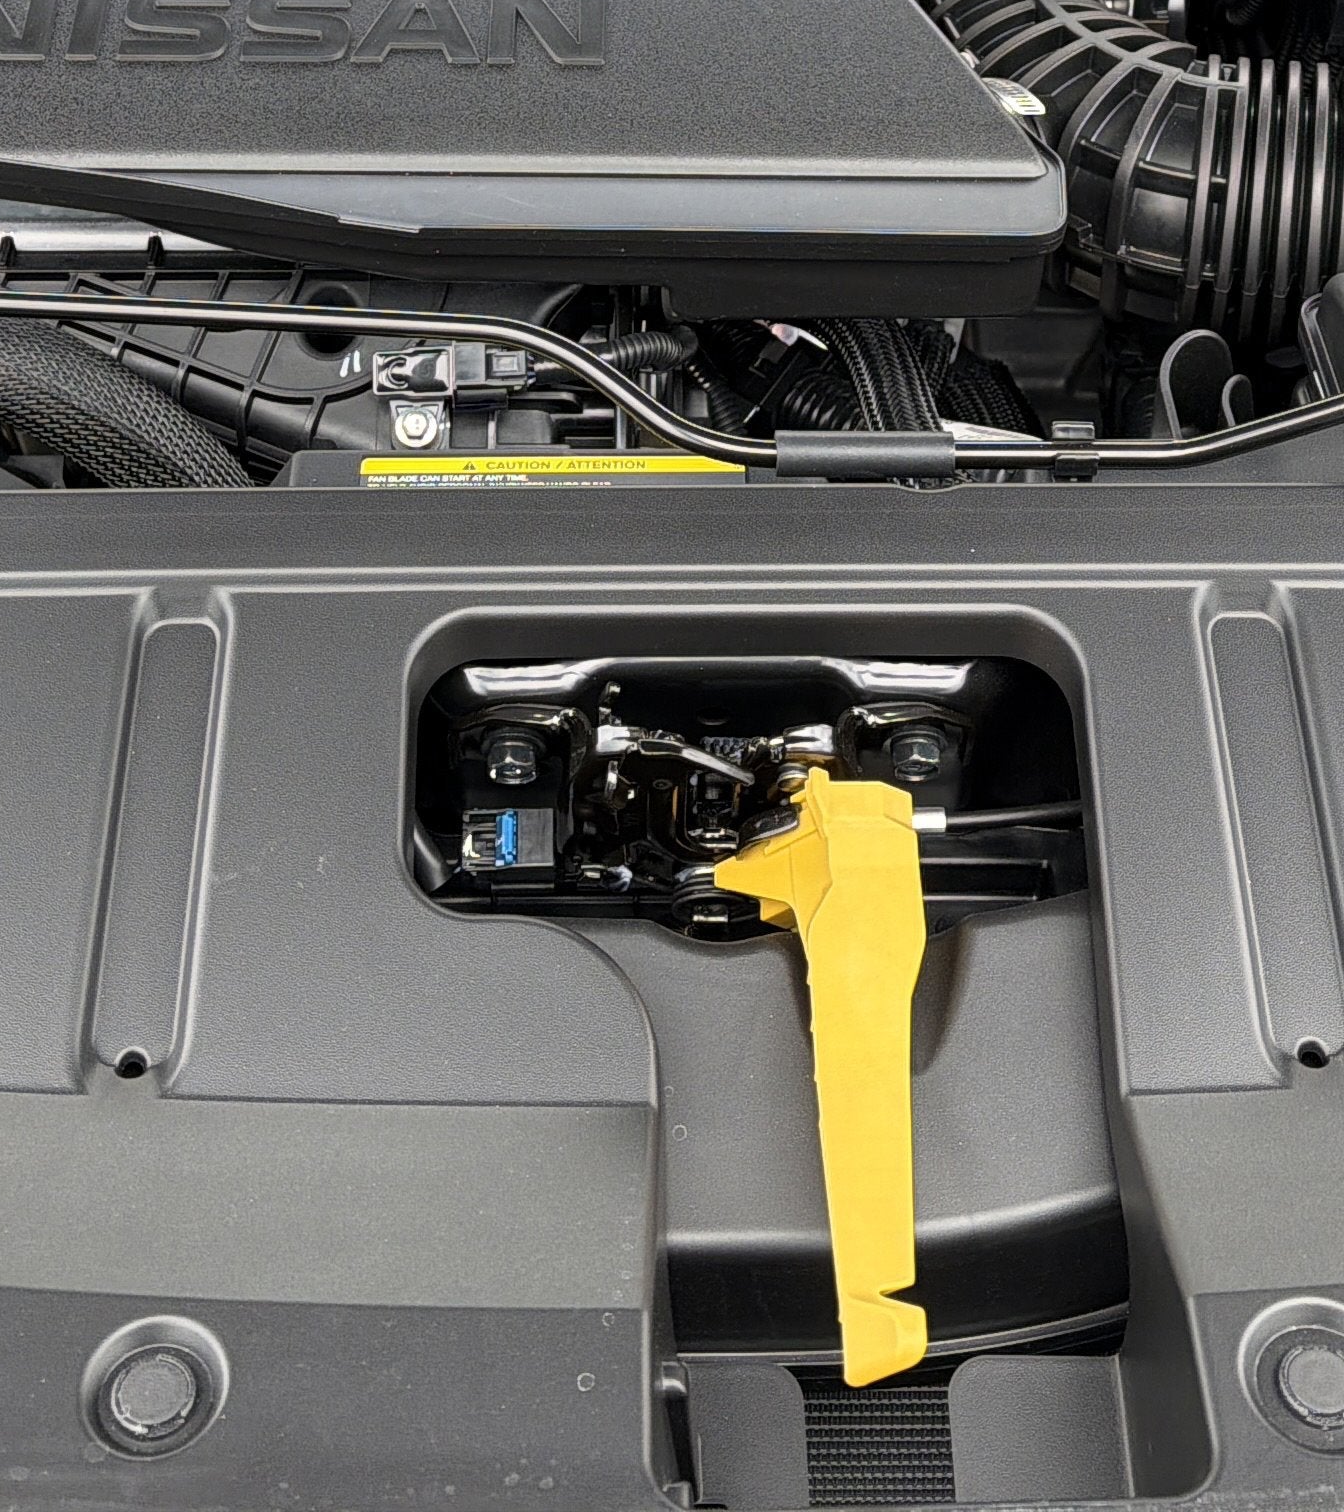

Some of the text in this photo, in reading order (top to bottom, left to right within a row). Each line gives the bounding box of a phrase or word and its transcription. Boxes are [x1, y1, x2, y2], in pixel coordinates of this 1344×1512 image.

[485, 460, 551, 470] CAUTION
[566, 460, 646, 469] ATTENTION
[367, 475, 386, 483] FAN
[387, 475, 418, 483] BLADE
[419, 475, 441, 483] CAN
[441, 474, 471, 483] START
[471, 474, 484, 482] AT
[485, 474, 505, 482] ANY
